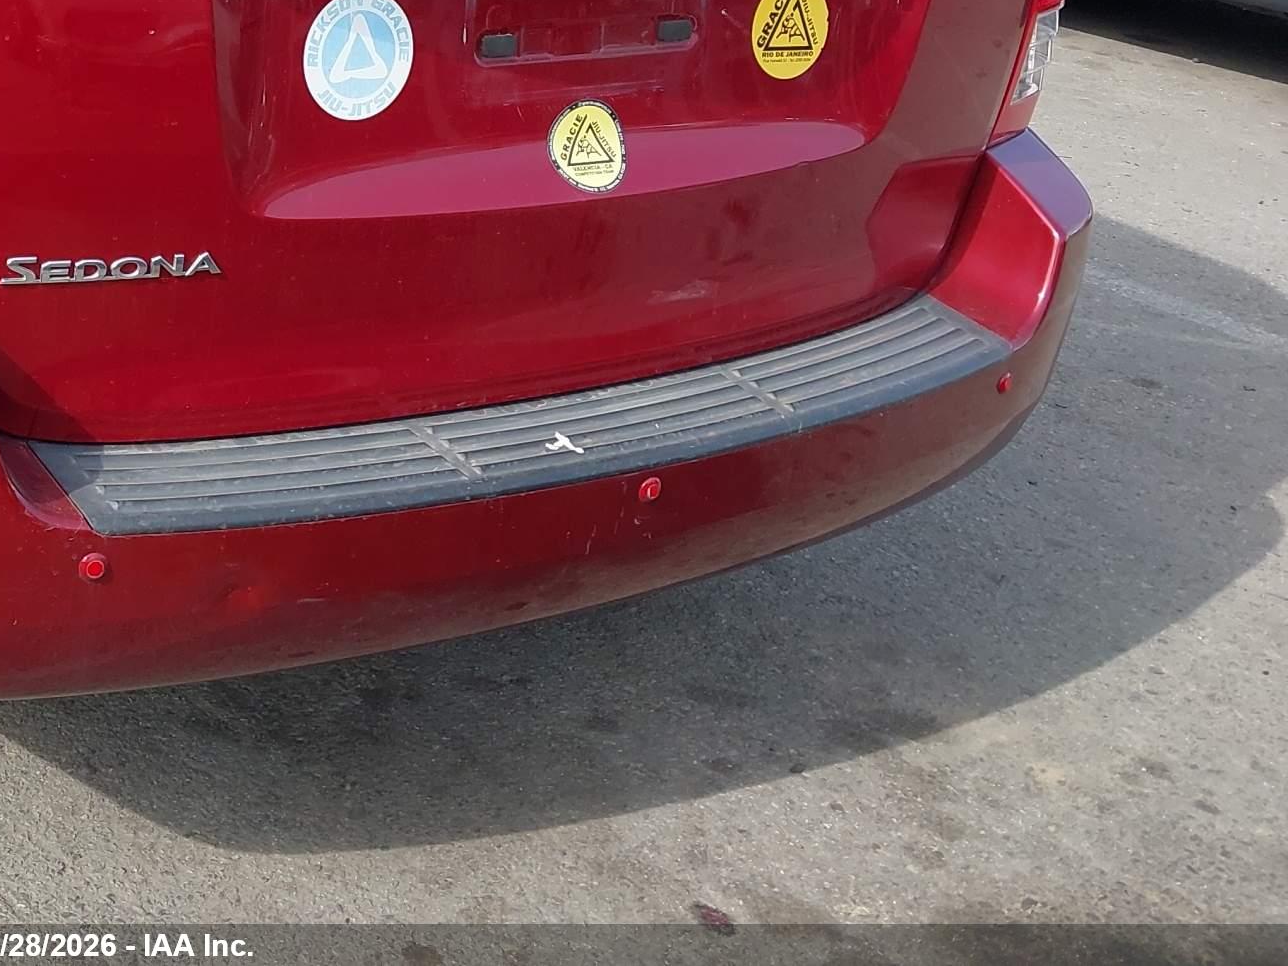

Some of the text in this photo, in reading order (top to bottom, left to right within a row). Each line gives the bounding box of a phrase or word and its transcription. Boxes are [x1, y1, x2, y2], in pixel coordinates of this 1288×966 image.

[317, 81, 397, 118] JIU-JITSU
[560, 114, 583, 161] GRACIE
[591, 121, 617, 158] JIU-JITSU
[0, 251, 222, 285] SEDONA
